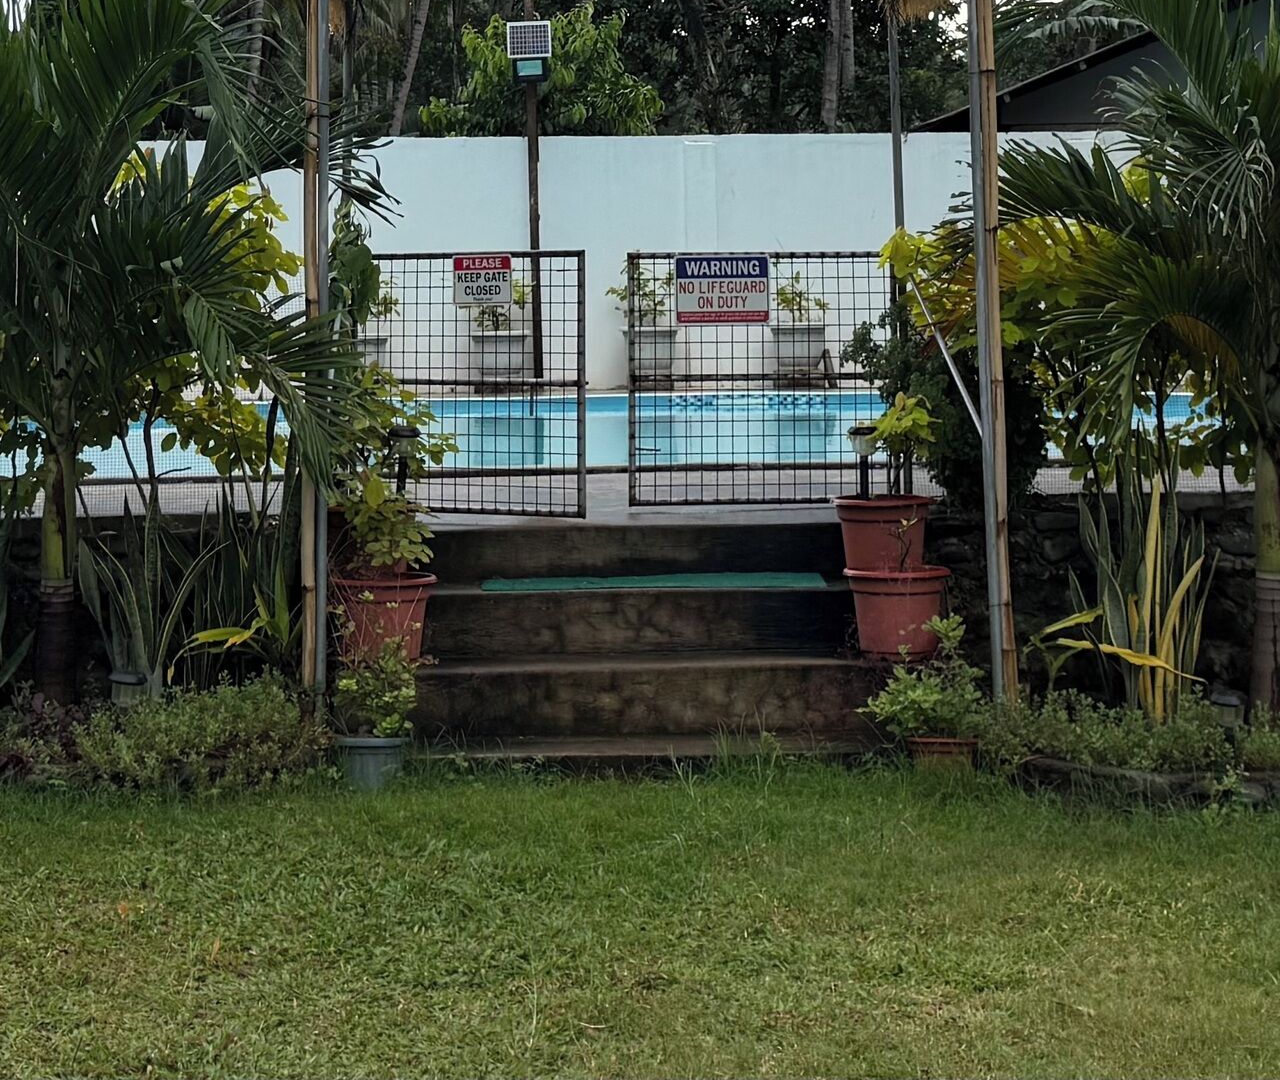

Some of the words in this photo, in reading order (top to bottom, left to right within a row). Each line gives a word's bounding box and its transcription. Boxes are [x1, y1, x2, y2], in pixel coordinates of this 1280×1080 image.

[462, 258, 502, 268] PLEASE
[685, 260, 760, 276] WARNING
[457, 272, 481, 283] KEEP
[484, 271, 508, 282] GATE
[464, 284, 501, 296] CLOSED
[679, 281, 695, 294] NO
[699, 280, 766, 294] LIFEGUARD
[697, 296, 713, 309] ON
[717, 295, 748, 308] DUTY
